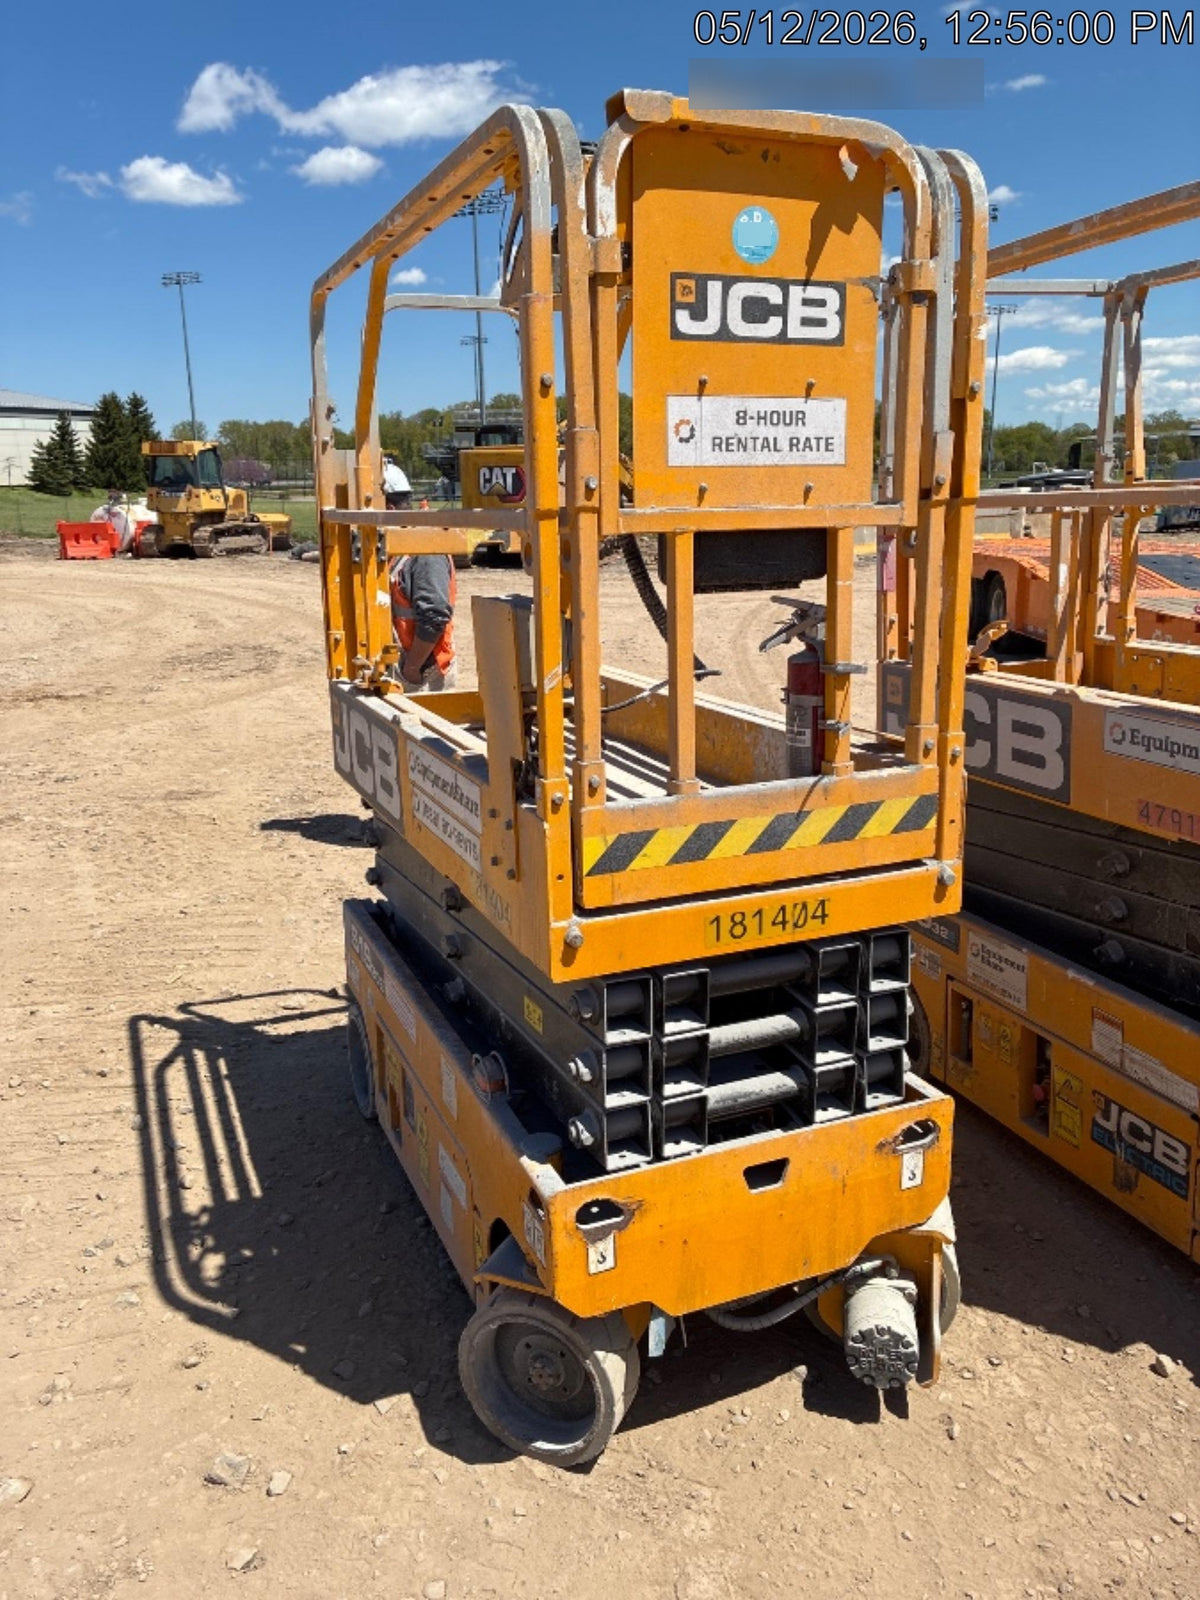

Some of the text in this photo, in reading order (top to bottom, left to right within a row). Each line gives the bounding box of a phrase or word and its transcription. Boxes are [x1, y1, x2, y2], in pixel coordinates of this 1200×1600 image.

[675, 280, 841, 340] JCB
[735, 408, 807, 427] 8-HOUR
[711, 437, 835, 453] RENTAL RATE
[480, 466, 516, 495] CAT
[336, 702, 401, 820] JCB
[709, 898, 830, 943] 181404
[1094, 1101, 1188, 1176] JCB
